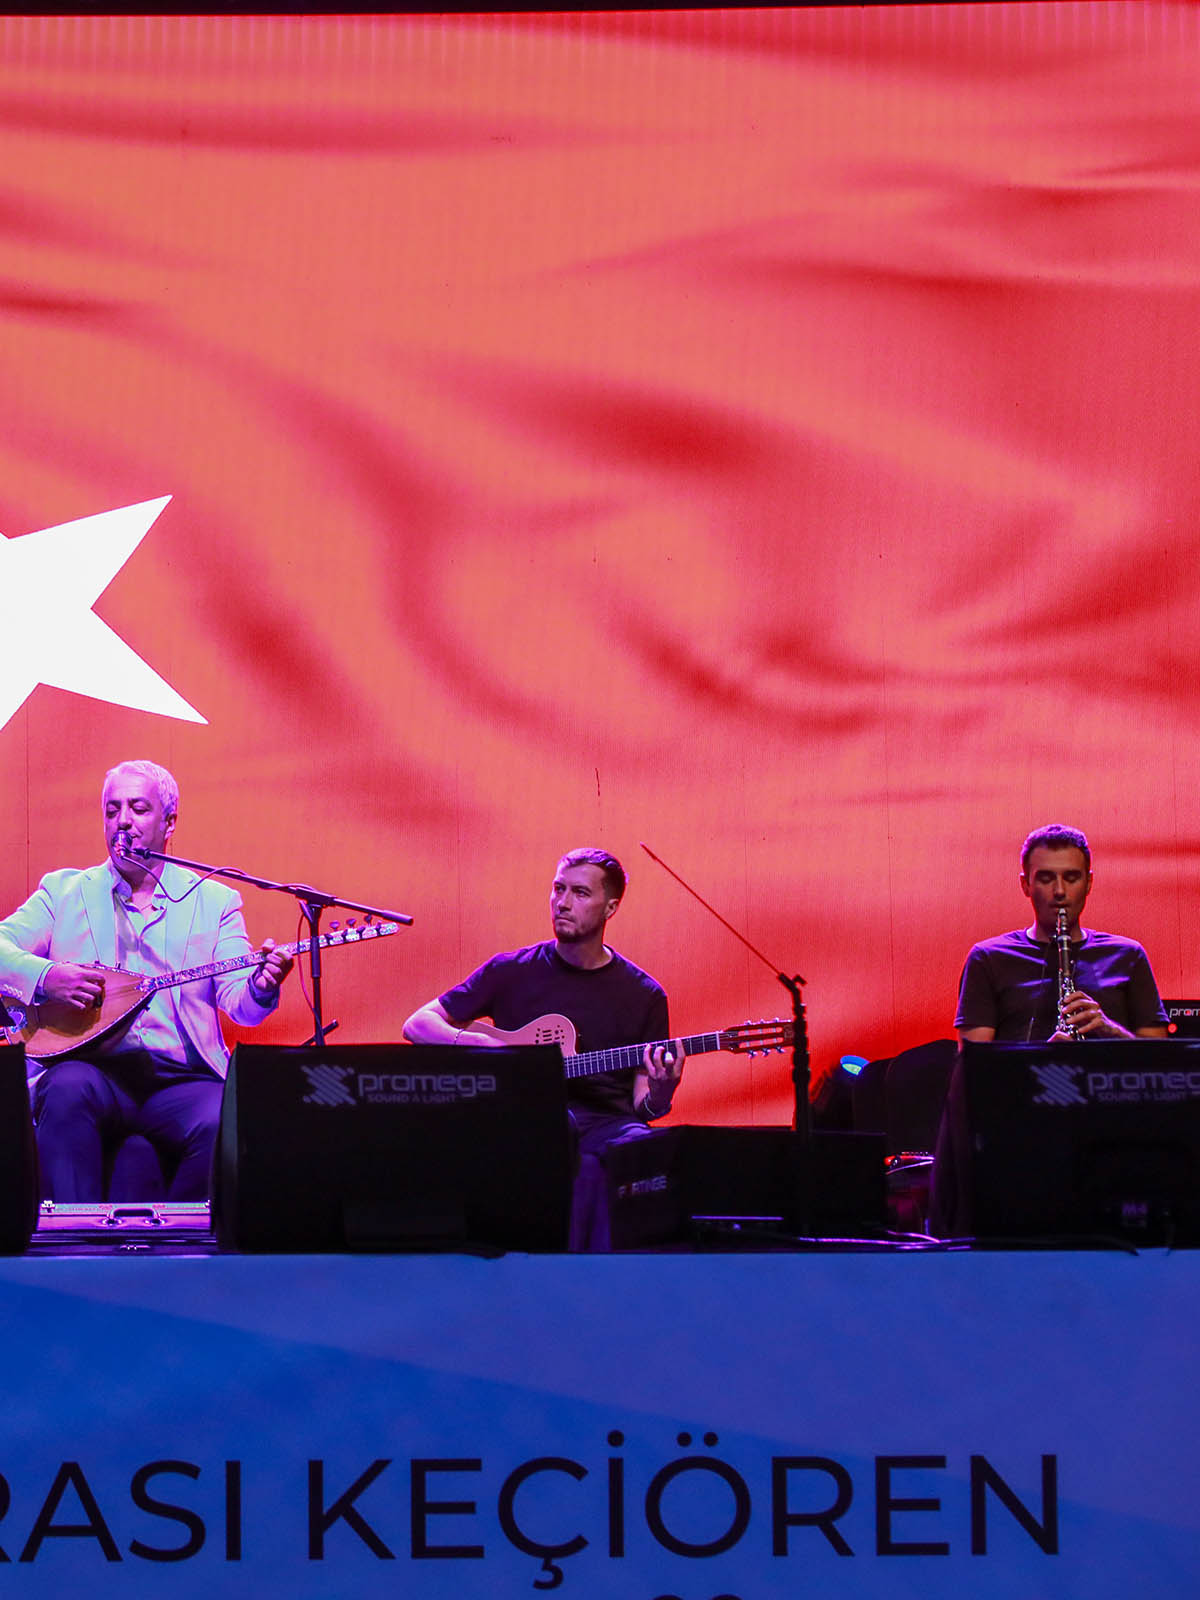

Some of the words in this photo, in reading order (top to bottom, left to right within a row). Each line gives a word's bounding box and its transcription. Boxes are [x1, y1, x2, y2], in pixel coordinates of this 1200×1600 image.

[358, 1074, 497, 1098] promega
[367, 1093, 409, 1104] SOUND
[422, 1094, 456, 1104] LIGHT
[307, 1430, 1059, 1590] KEÇİÖREN
